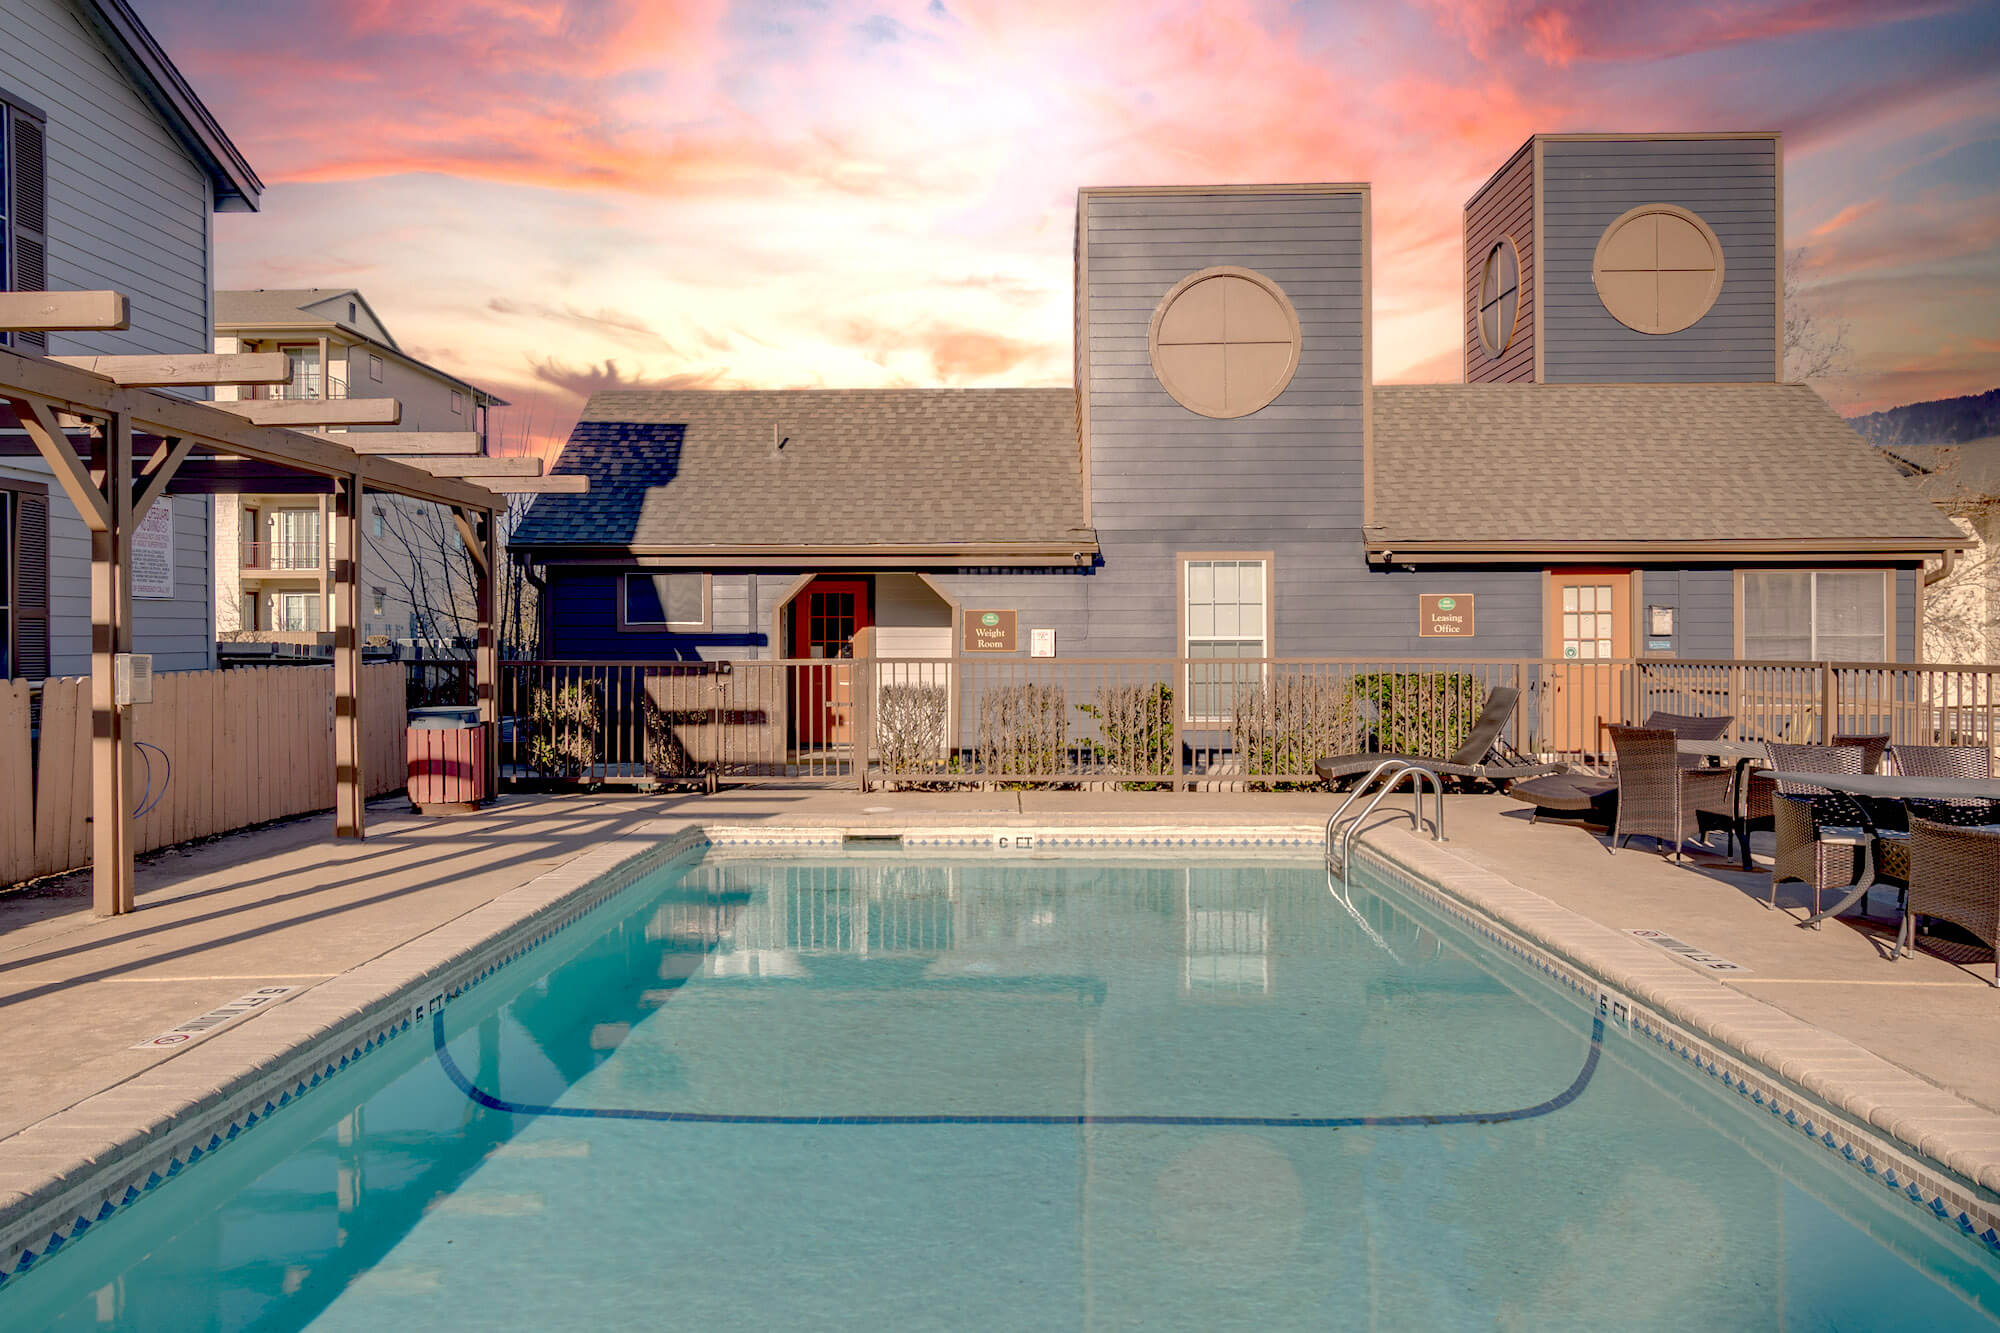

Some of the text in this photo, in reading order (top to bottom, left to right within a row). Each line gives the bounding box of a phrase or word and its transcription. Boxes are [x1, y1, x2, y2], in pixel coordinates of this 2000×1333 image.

[1431, 613, 1463, 623] Leasing
[975, 628, 1006, 638] Weight
[1433, 624, 1461, 633] Office
[977, 639, 1003, 648] Room
[230, 997, 271, 1007] FT
[416, 993, 443, 1023] 5 FT
[1600, 994, 1628, 1023] 5 FT
